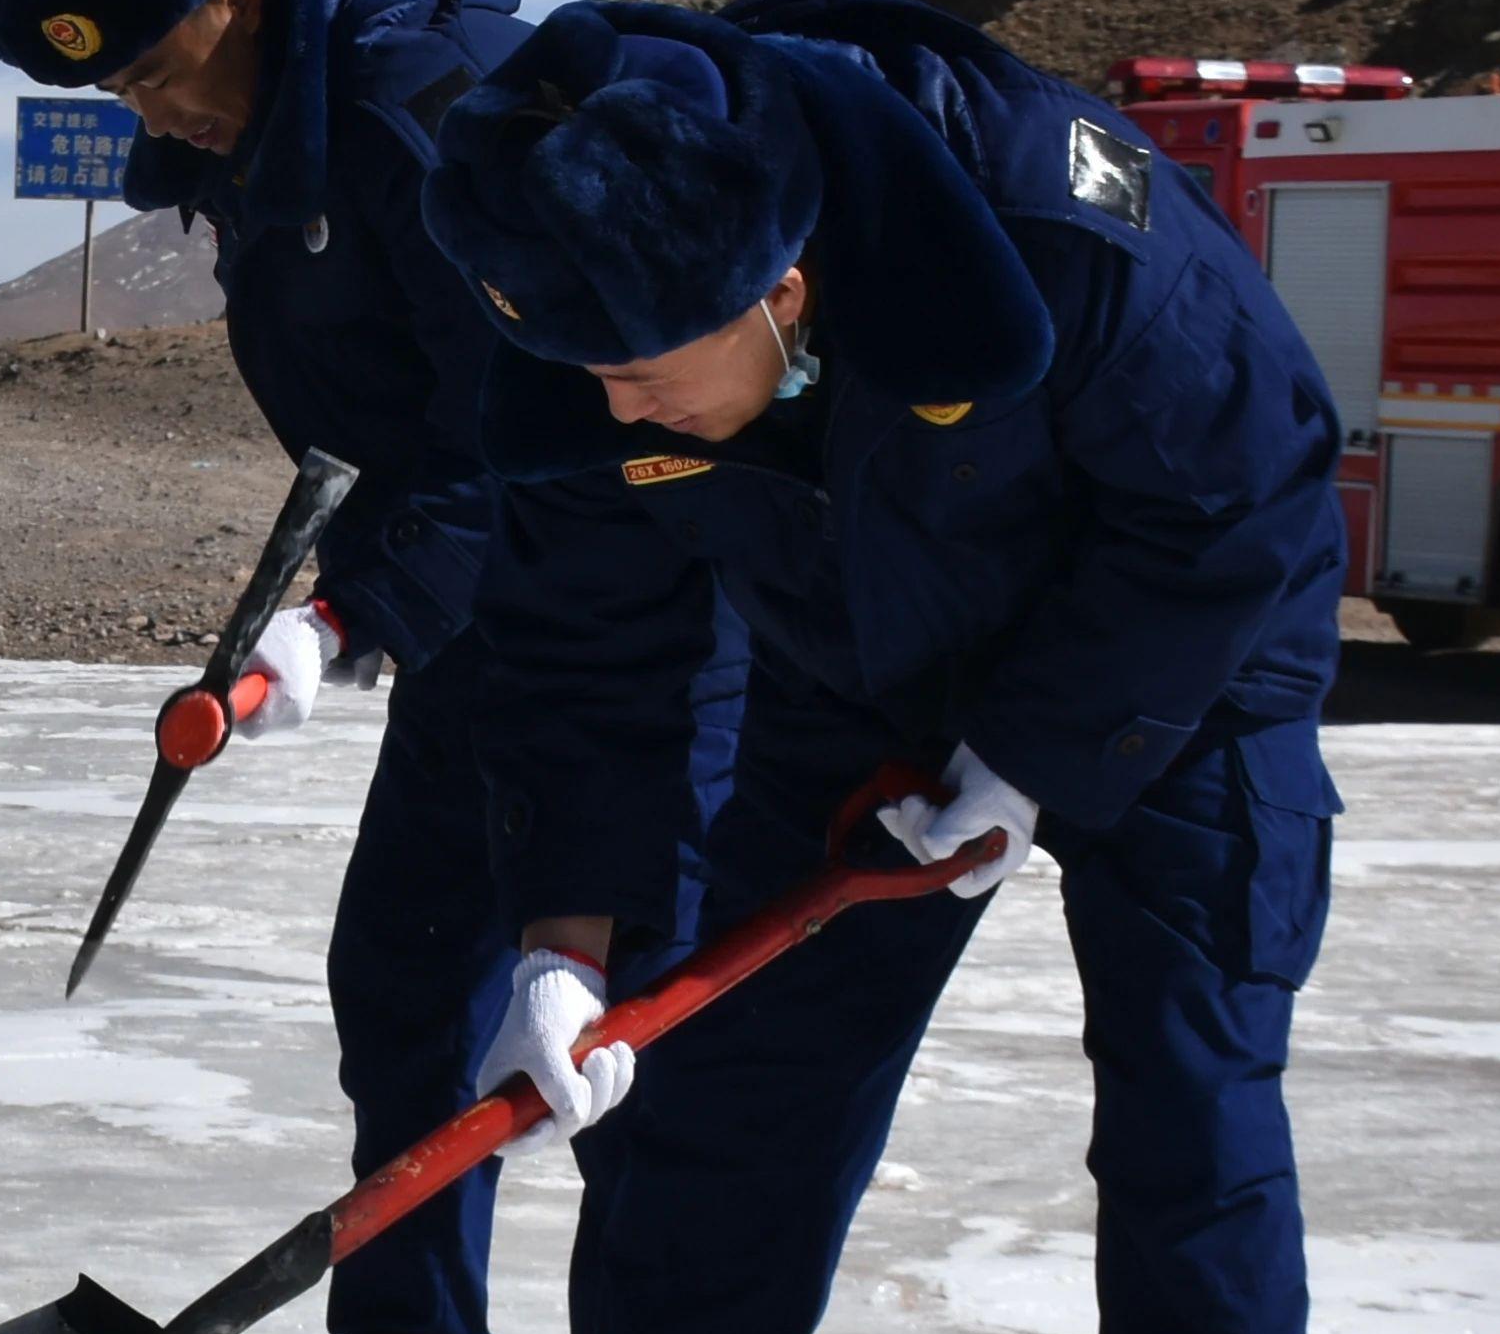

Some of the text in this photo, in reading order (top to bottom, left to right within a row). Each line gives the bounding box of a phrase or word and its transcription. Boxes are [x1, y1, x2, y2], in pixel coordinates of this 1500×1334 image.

[33, 111, 98, 128] 交警提示
[628, 464, 656, 479] 26X
